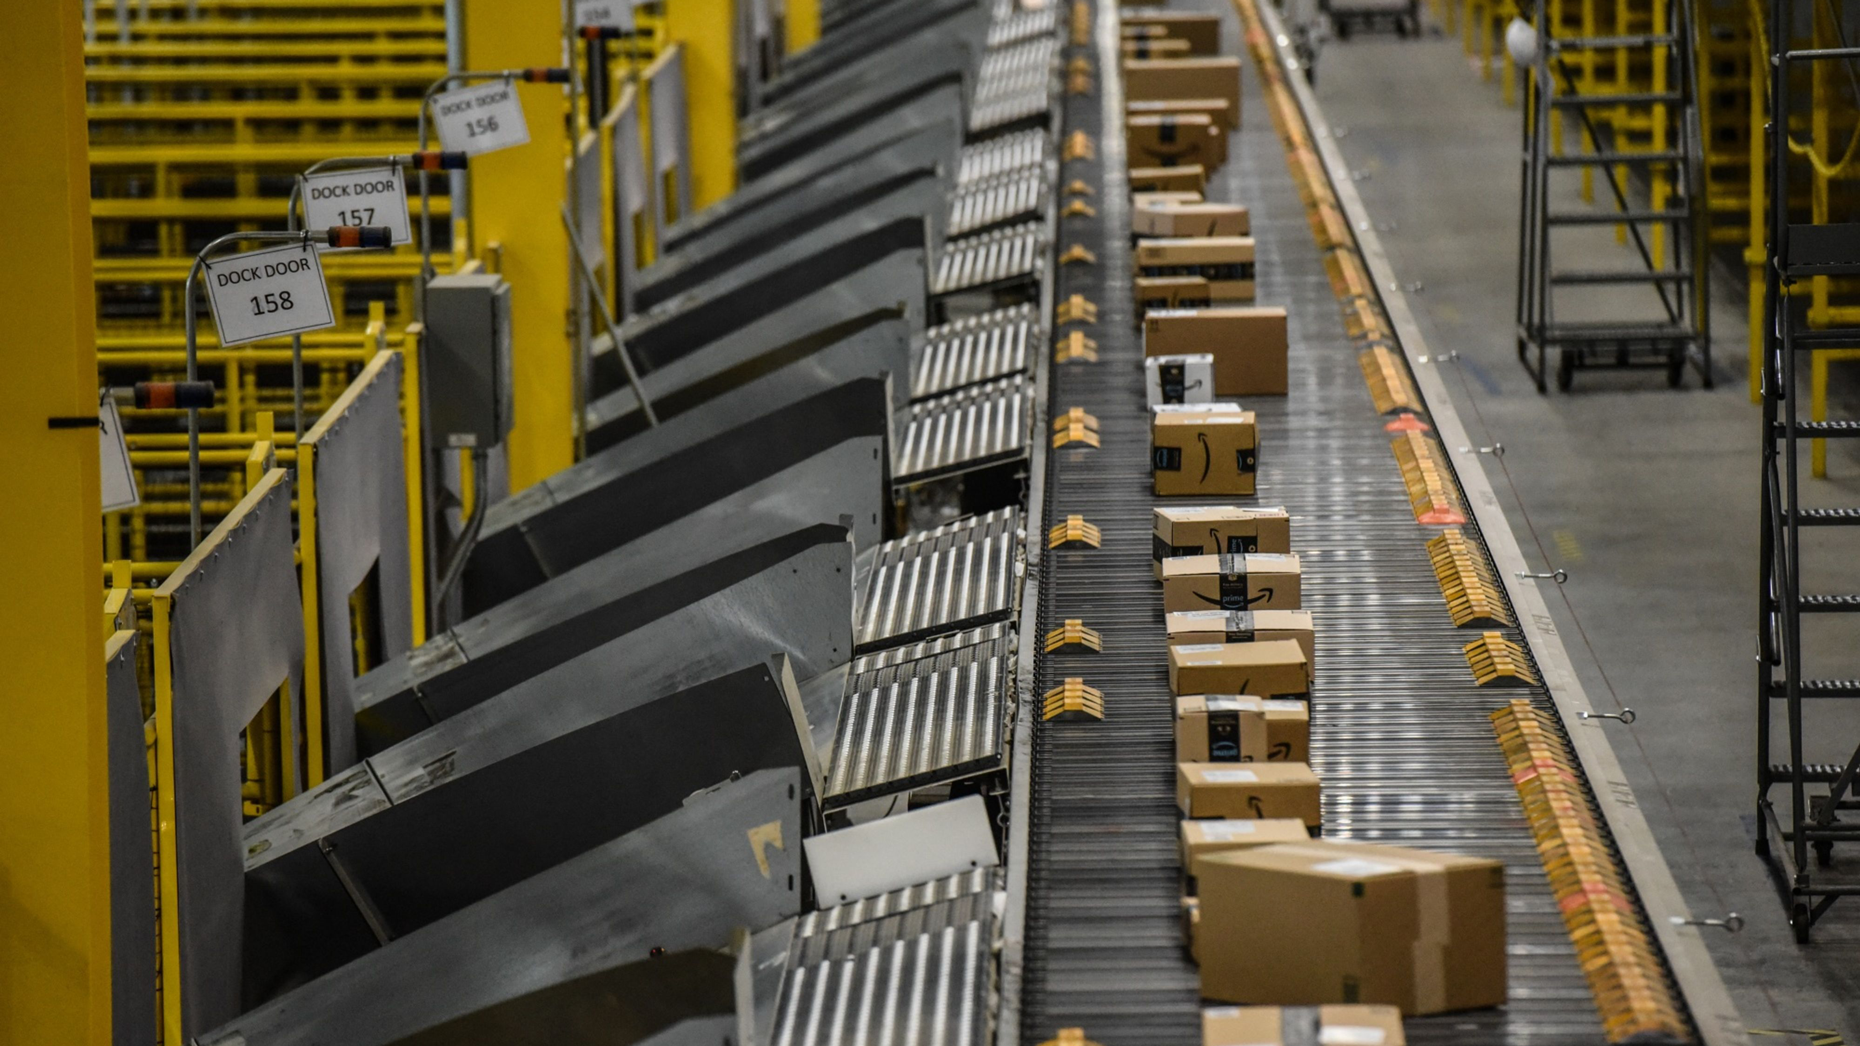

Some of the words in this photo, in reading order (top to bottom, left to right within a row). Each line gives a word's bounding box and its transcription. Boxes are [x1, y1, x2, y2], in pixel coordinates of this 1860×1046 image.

[441, 100, 474, 117] DOCK
[475, 90, 510, 108] DOOR
[466, 115, 499, 138] 156
[311, 185, 351, 200] DOCK
[353, 180, 395, 195] DOOR
[337, 207, 376, 227] 157
[217, 266, 262, 287] DOCK
[264, 257, 311, 278] DOOR
[250, 290, 294, 316] 158
[1222, 594, 1244, 603] prime
